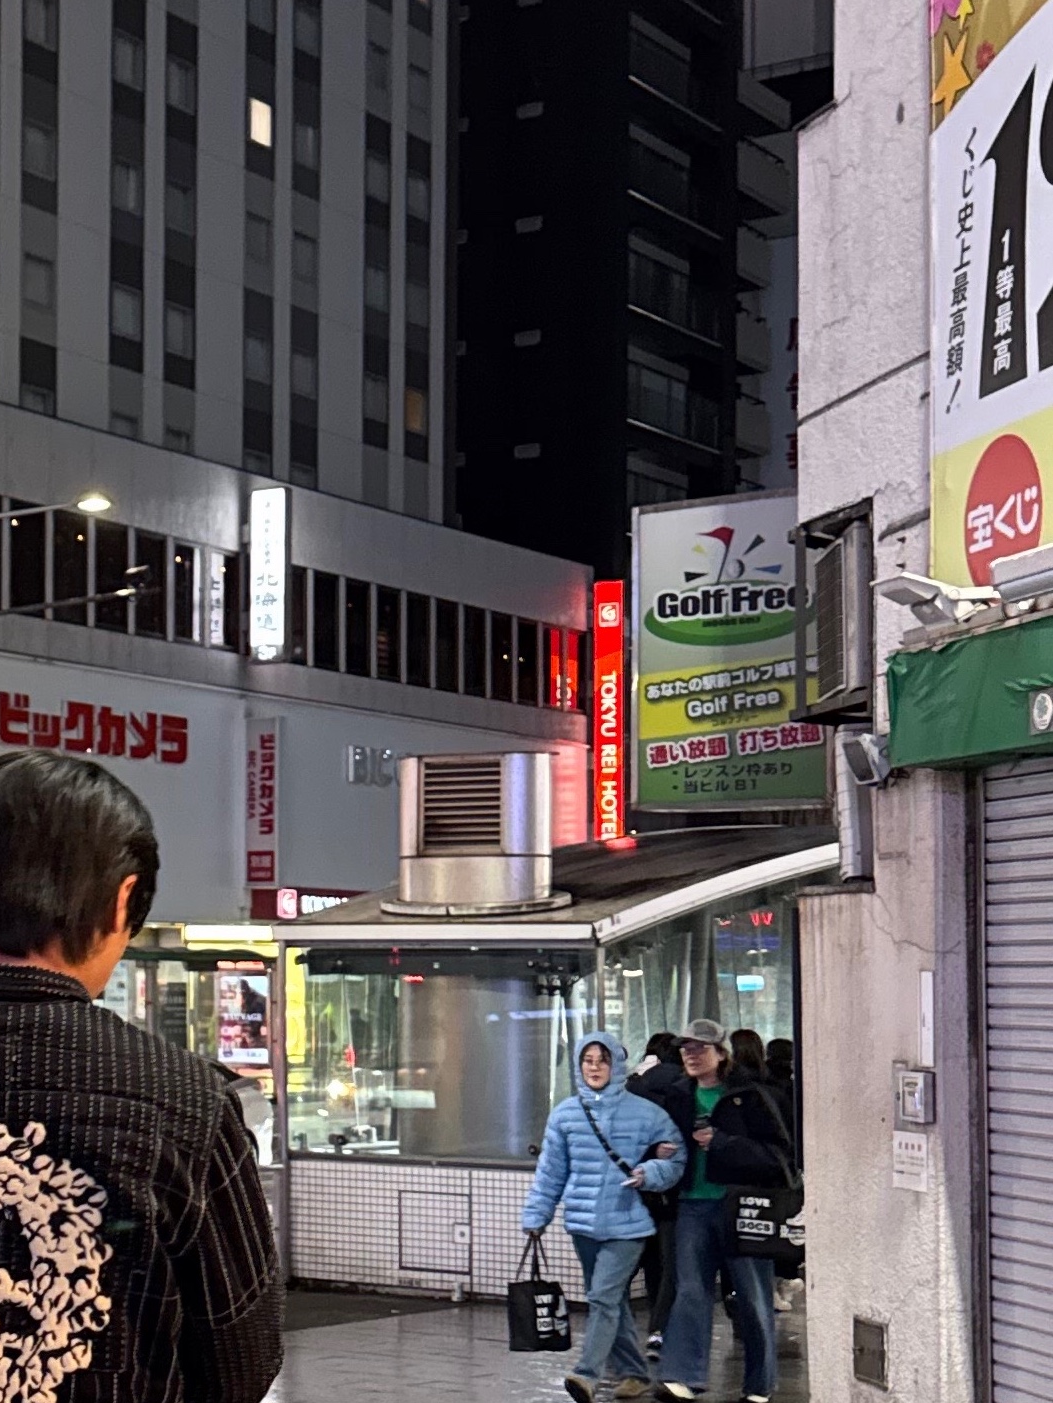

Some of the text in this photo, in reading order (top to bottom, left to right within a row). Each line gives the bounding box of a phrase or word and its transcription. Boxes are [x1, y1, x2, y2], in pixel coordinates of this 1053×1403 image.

[967, 485, 1040, 554] 宝くじ
[256, 572, 279, 632] 北海道
[657, 585, 726, 619] Golf
[600, 671, 617, 737] TOKYU
[687, 691, 781, 718] Golf Free
[600, 744, 617, 773] REI
[648, 723, 822, 765] 通い放題 打ち放題
[259, 733, 275, 836] ビックカメラ
[739, 1196, 771, 1208] LOVE
